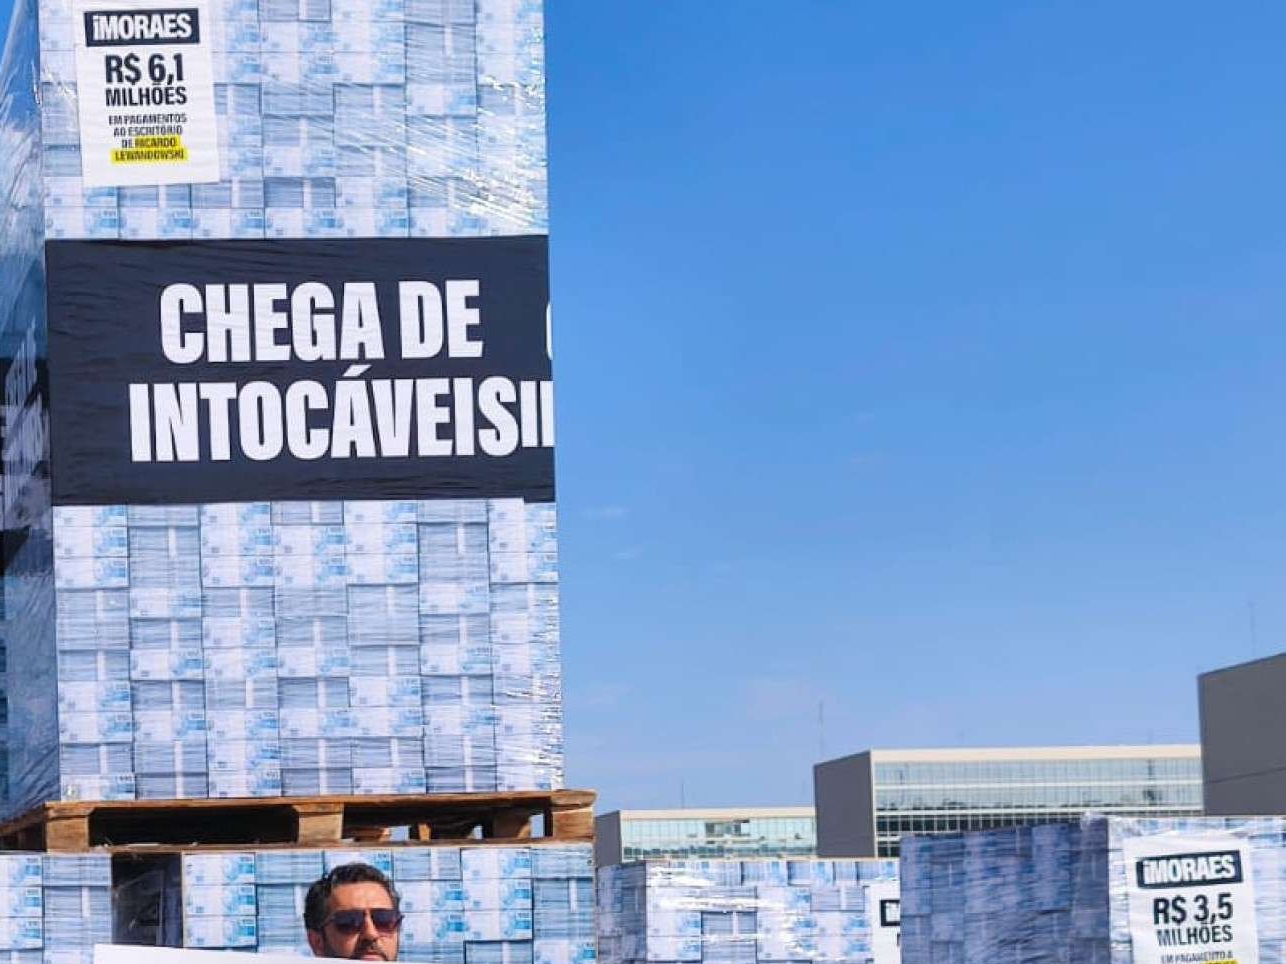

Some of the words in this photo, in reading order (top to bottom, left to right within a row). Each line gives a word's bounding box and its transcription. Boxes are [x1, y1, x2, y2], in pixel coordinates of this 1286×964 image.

[105, 52, 142, 85] R$
[149, 53, 184, 85] 6,1
[105, 83, 188, 107] MILHÕES
[160, 281, 385, 365] CHEGA
[399, 279, 484, 360] DE
[1153, 894, 1187, 925] R$
[1193, 892, 1233, 924] 3,5
[1157, 921, 1233, 946] MILHÕES
